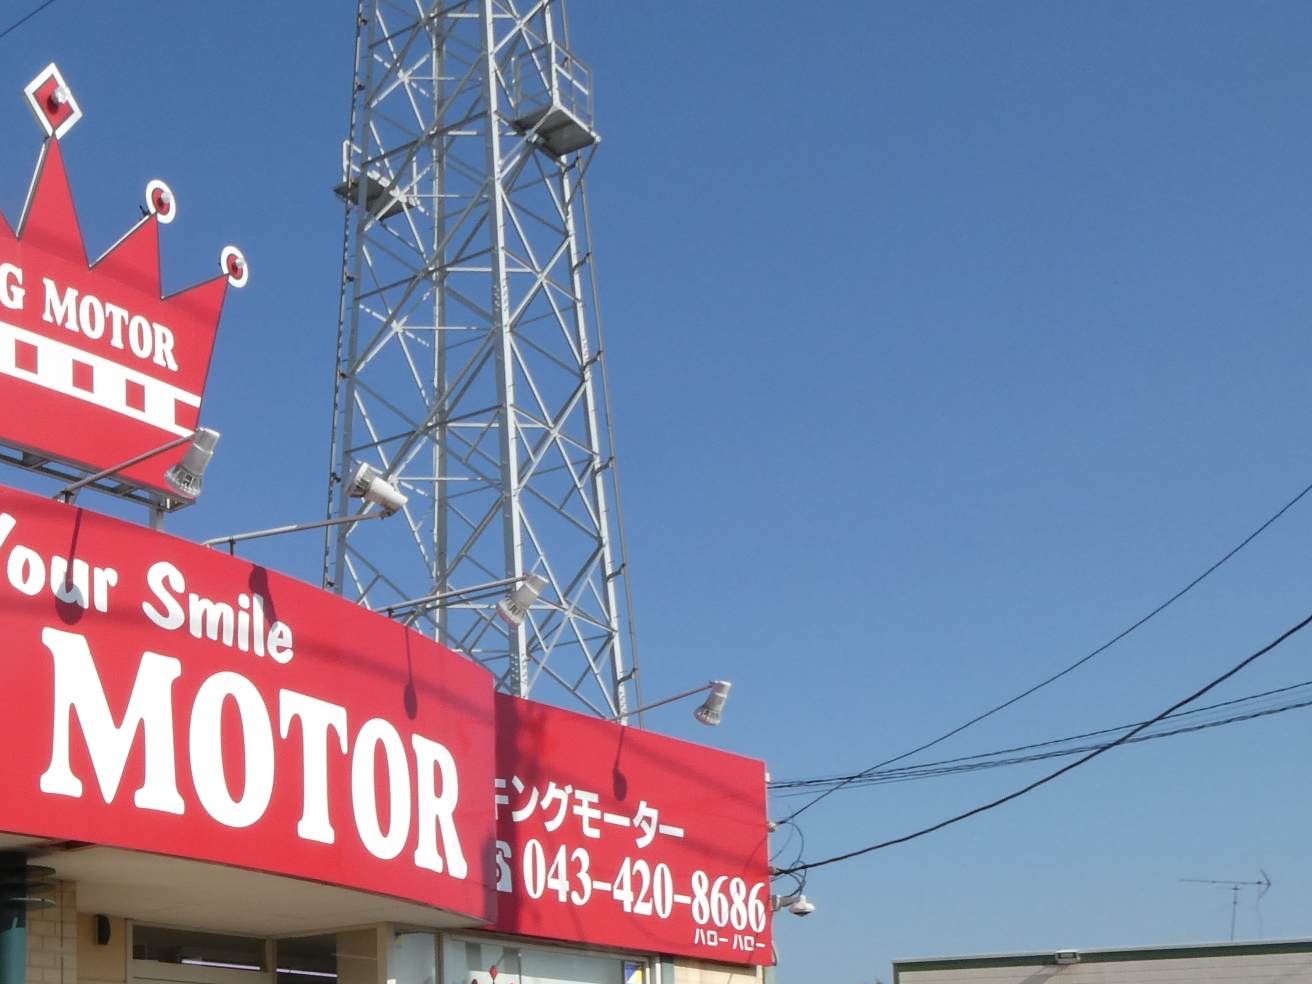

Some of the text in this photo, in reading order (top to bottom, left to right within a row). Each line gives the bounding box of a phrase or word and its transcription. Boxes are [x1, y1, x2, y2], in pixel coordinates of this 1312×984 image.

[42, 277, 178, 372] MOTOR
[142, 560, 294, 665] Smile
[39, 626, 467, 880] MOTOR
[522, 838, 766, 933] 043-420-8686
[695, 928, 766, 952] ハロー ハロー
